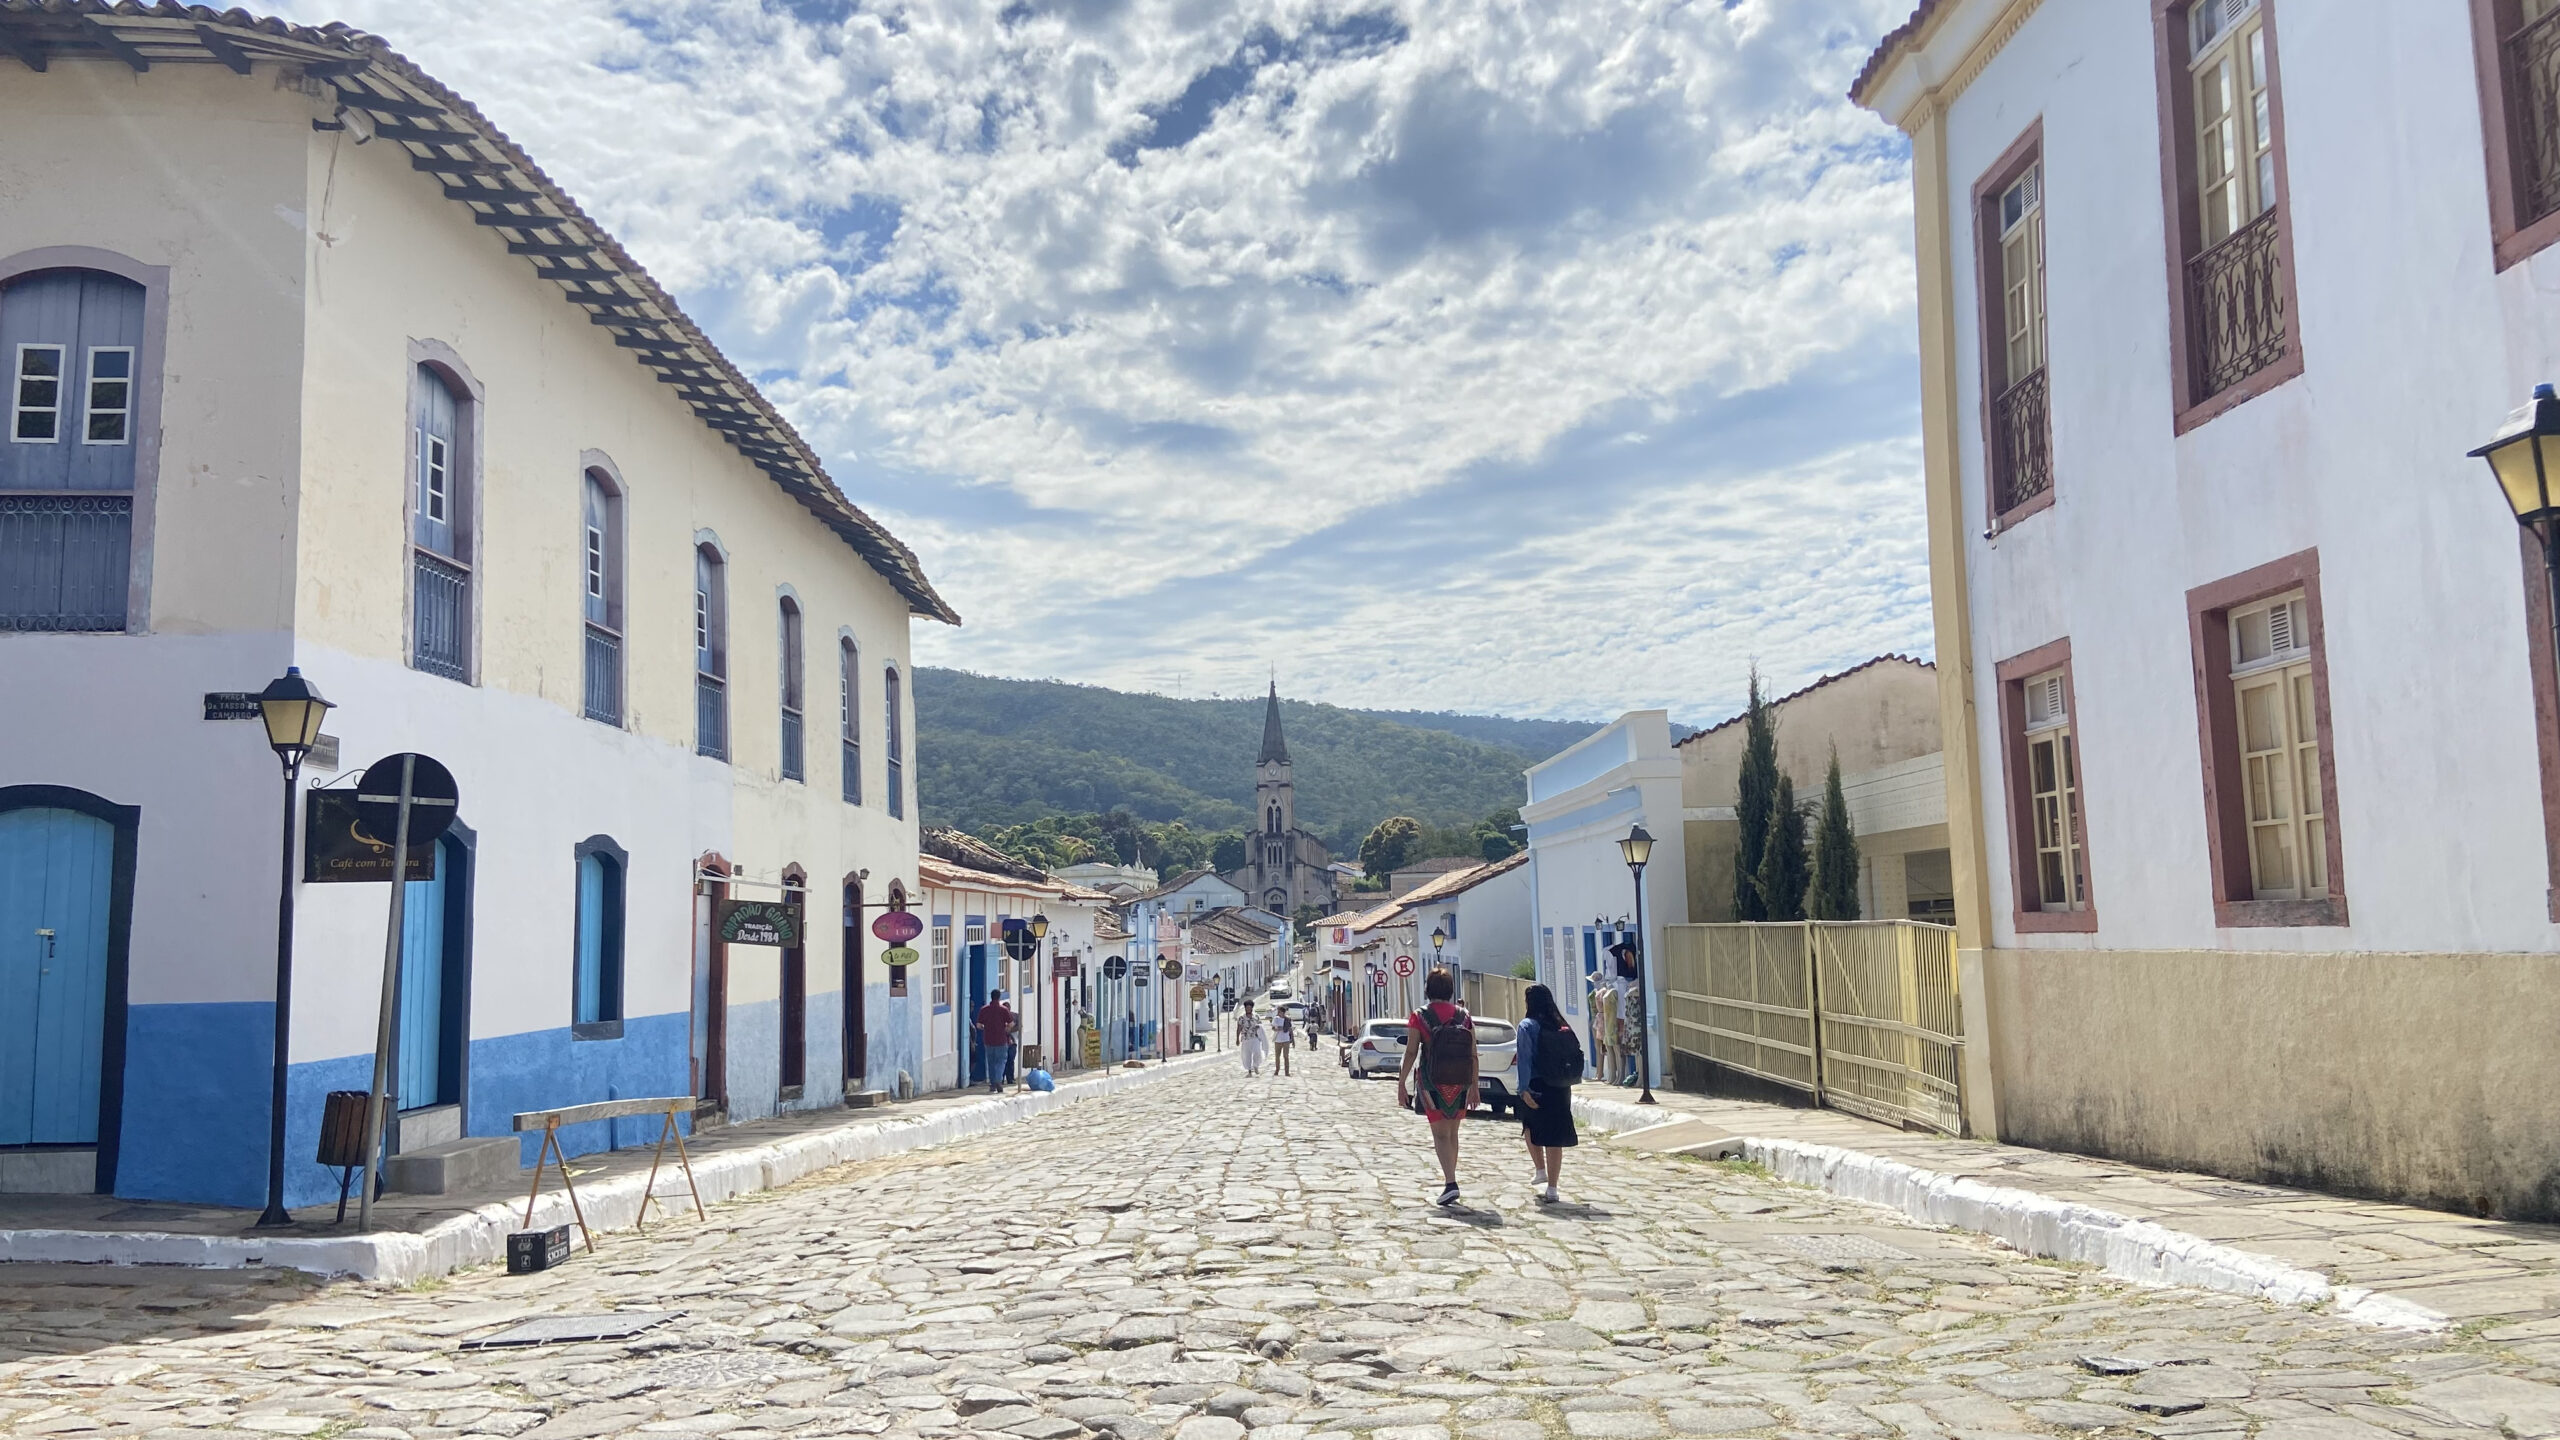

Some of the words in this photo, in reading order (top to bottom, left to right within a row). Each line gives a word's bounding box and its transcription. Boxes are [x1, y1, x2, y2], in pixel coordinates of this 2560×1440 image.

[212, 711, 252, 719] CAMARGO
[330, 858, 354, 870] Café
[355, 860, 376, 868] com
[744, 922, 773, 931] TRADIÇÃO
[765, 906, 793, 939] GOIANO
[736, 929, 760, 942] Desde
[760, 931, 779, 943] 1984
